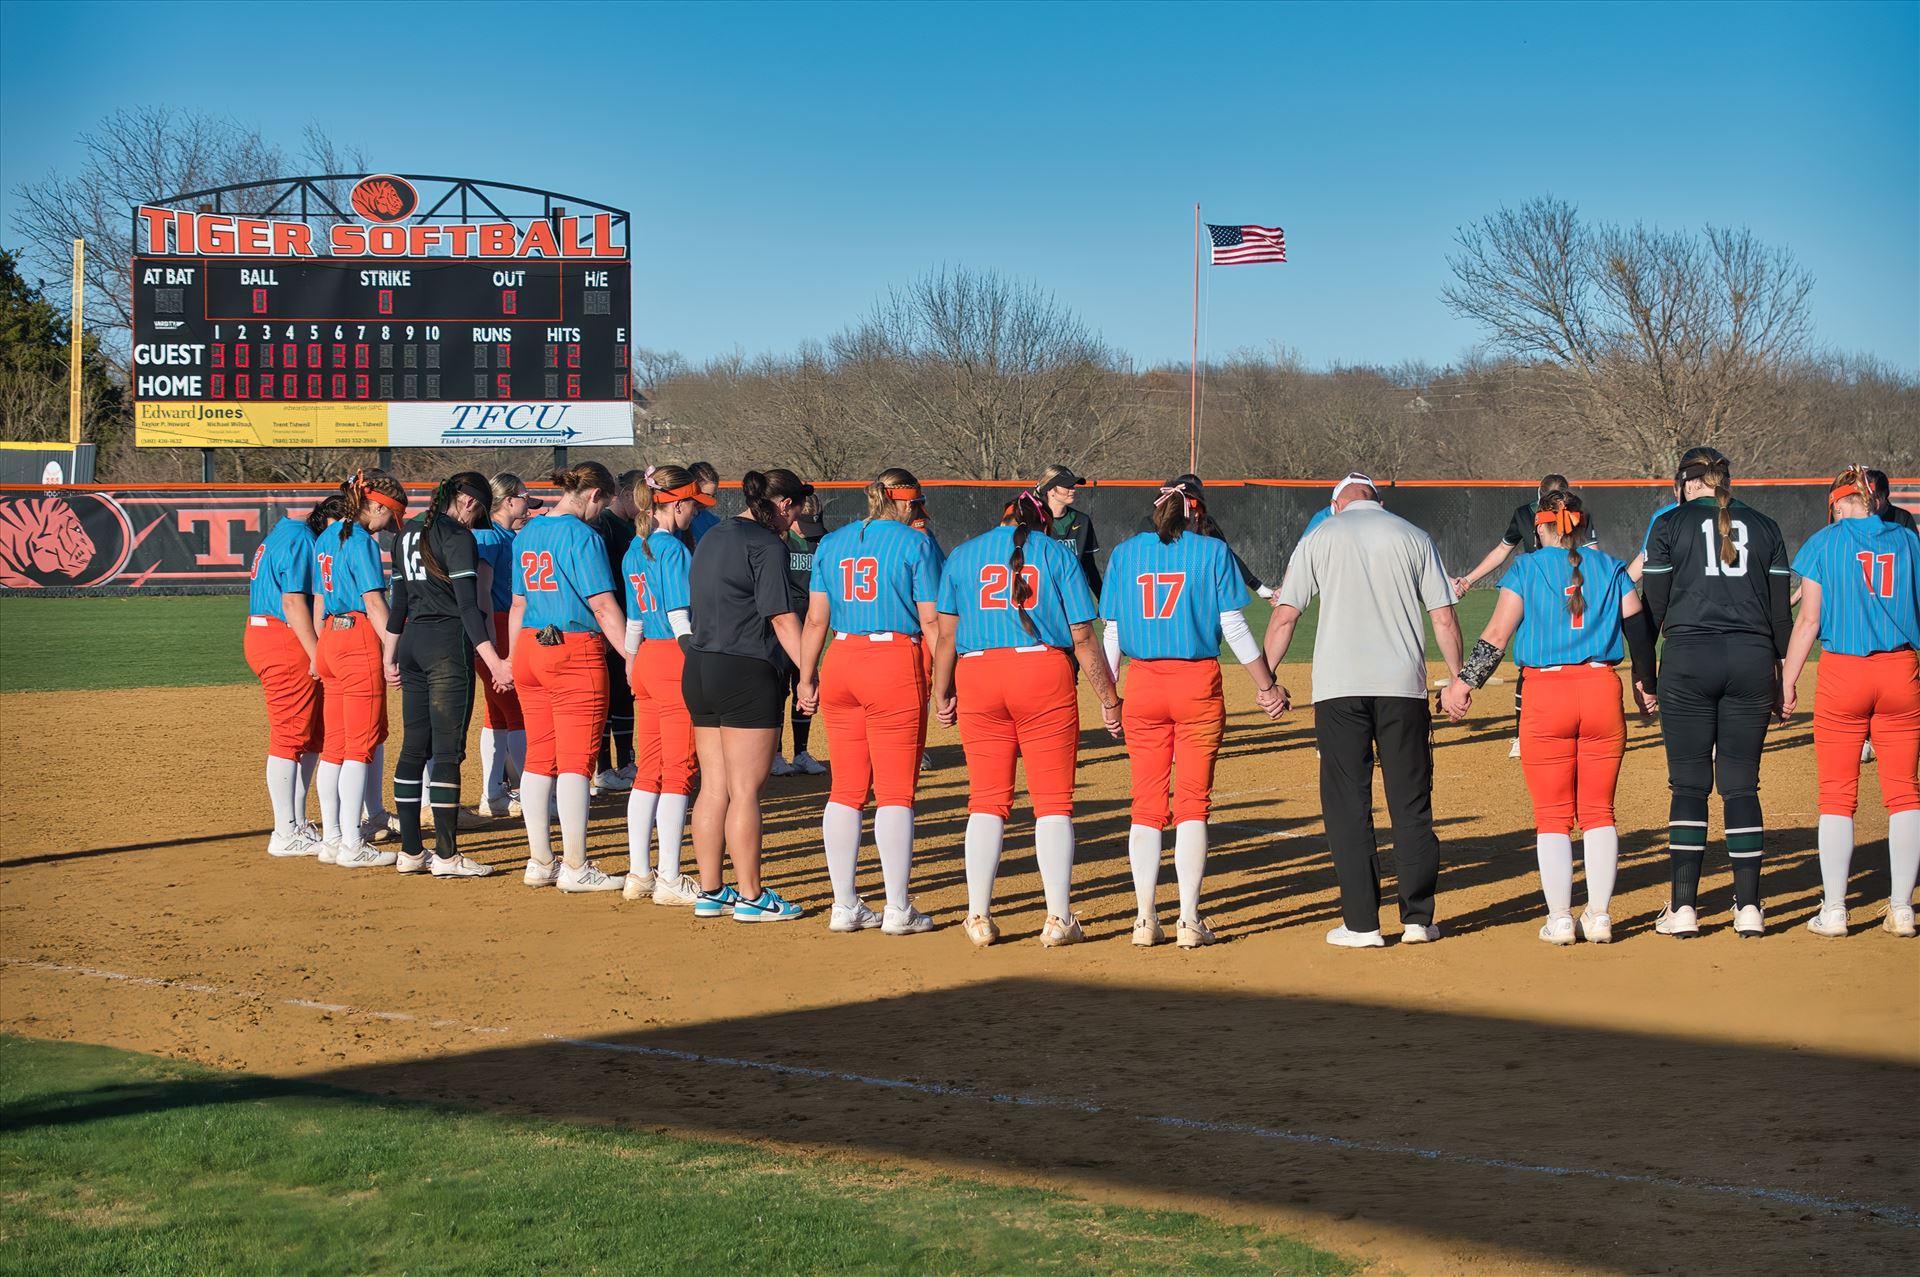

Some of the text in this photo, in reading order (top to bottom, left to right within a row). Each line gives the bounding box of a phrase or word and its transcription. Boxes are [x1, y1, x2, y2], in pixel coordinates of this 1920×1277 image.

[138, 205, 627, 258] TIGER SOFTBALL
[143, 269, 195, 285] AT BAT
[240, 269, 278, 285] BALL
[360, 270, 411, 287] STRIKE
[493, 271, 525, 287] OUT
[585, 271, 608, 287] H/E
[214, 325, 626, 342] 1 2 3 4 5 6 7 8 9 10 RUNS HITS E
[134, 344, 205, 365] GUEST
[211, 344, 225, 368] 3
[235, 344, 250, 368] 0
[283, 344, 298, 368] 0
[307, 344, 322, 368] 0
[332, 344, 346, 368] 3
[355, 344, 369, 368] 0
[138, 374, 202, 397] HOME
[211, 374, 225, 398] 0
[235, 374, 250, 398] 0
[260, 374, 274, 398] 2
[283, 374, 298, 398] 0
[307, 374, 322, 398] 0
[332, 374, 346, 398] 0
[356, 374, 369, 398] 3
[142, 404, 243, 420] Edward Jones
[450, 405, 572, 430] TFCU
[472, 437, 507, 445] Federal
[509, 437, 537, 445] Credit
[539, 437, 567, 445] Union
[521, 551, 558, 591] 22
[839, 556, 878, 602] 13
[1856, 551, 1895, 598] 11
[979, 564, 1040, 610] 20
[1137, 572, 1186, 620] 17
[1565, 585, 1584, 629] 1
